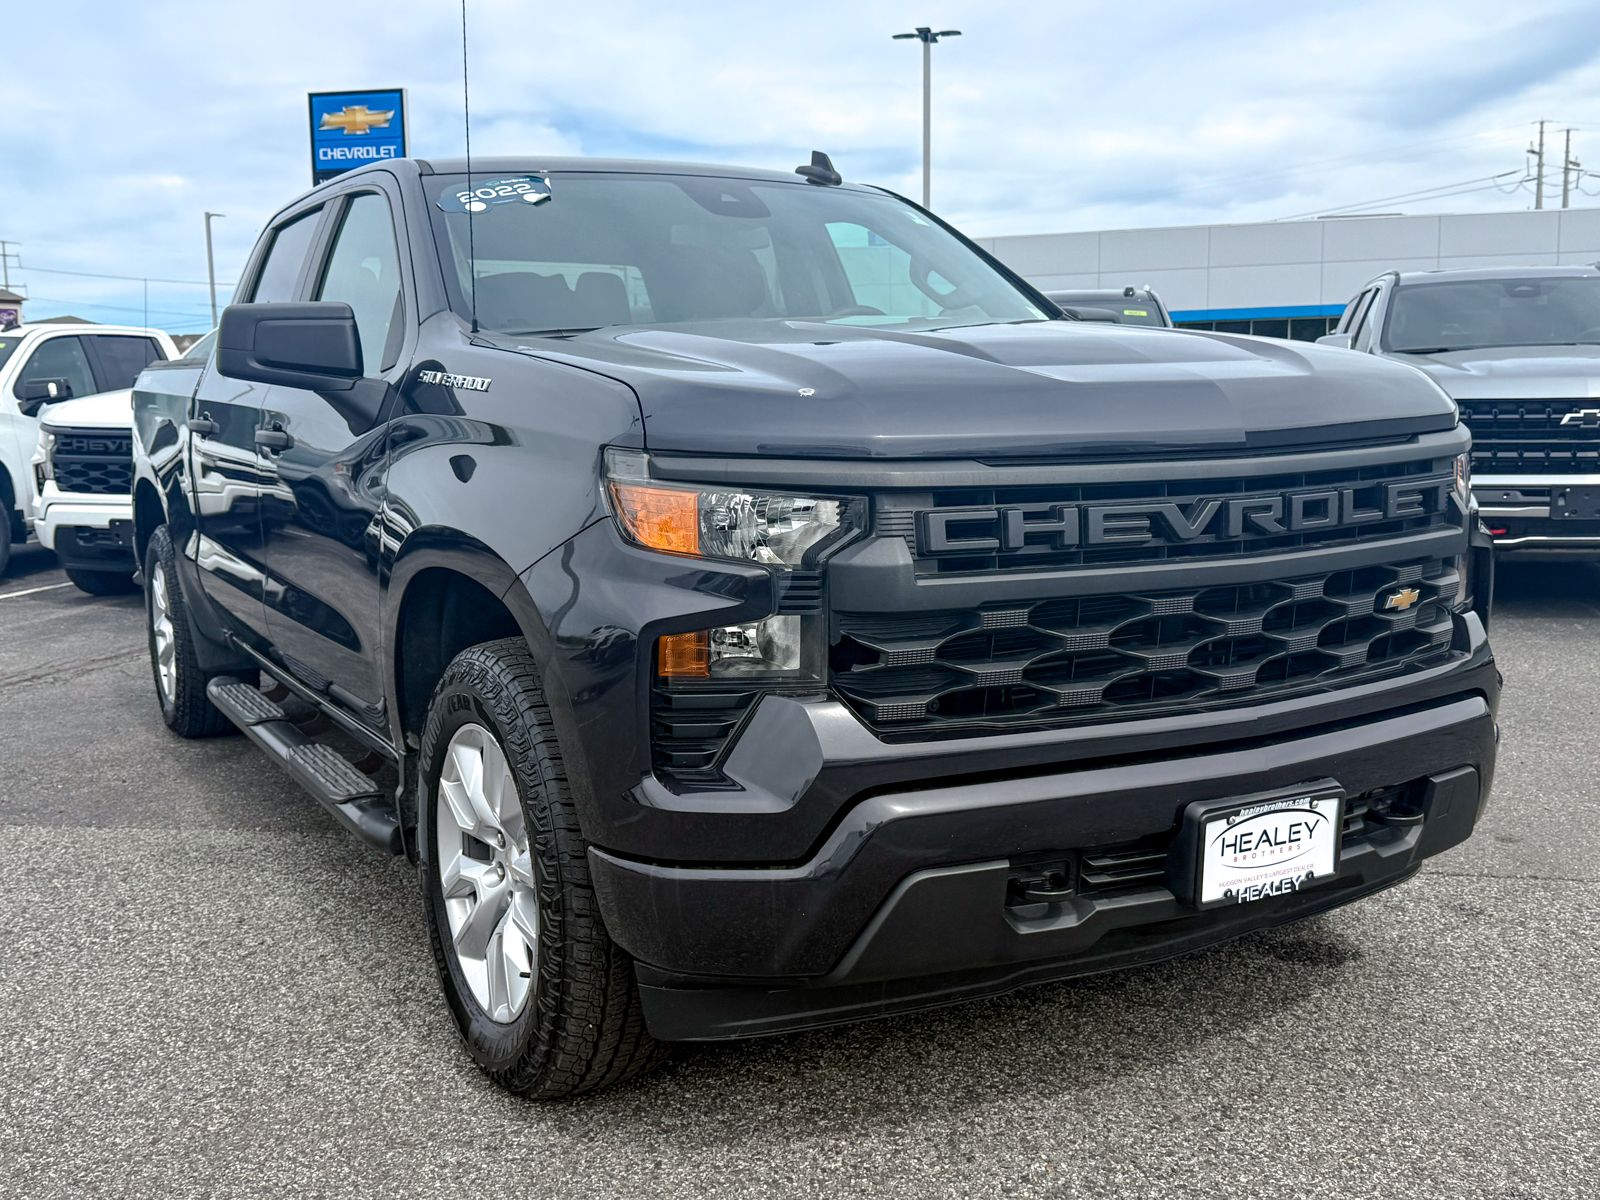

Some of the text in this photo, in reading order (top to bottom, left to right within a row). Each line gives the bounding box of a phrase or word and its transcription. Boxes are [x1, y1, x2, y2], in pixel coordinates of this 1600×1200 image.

[319, 145, 397, 160] CHEVROLET
[456, 183, 535, 203] 2022
[418, 369, 492, 392] SILVERADO
[1239, 797, 1311, 817] healeybrothers.com
[1221, 819, 1320, 857] HEALEY
[1233, 843, 1302, 863] BROTHERS
[1218, 863, 1315, 888] HUDSON VALLEY'S LARGEST DEALER
[1237, 875, 1302, 904] HEALEY
